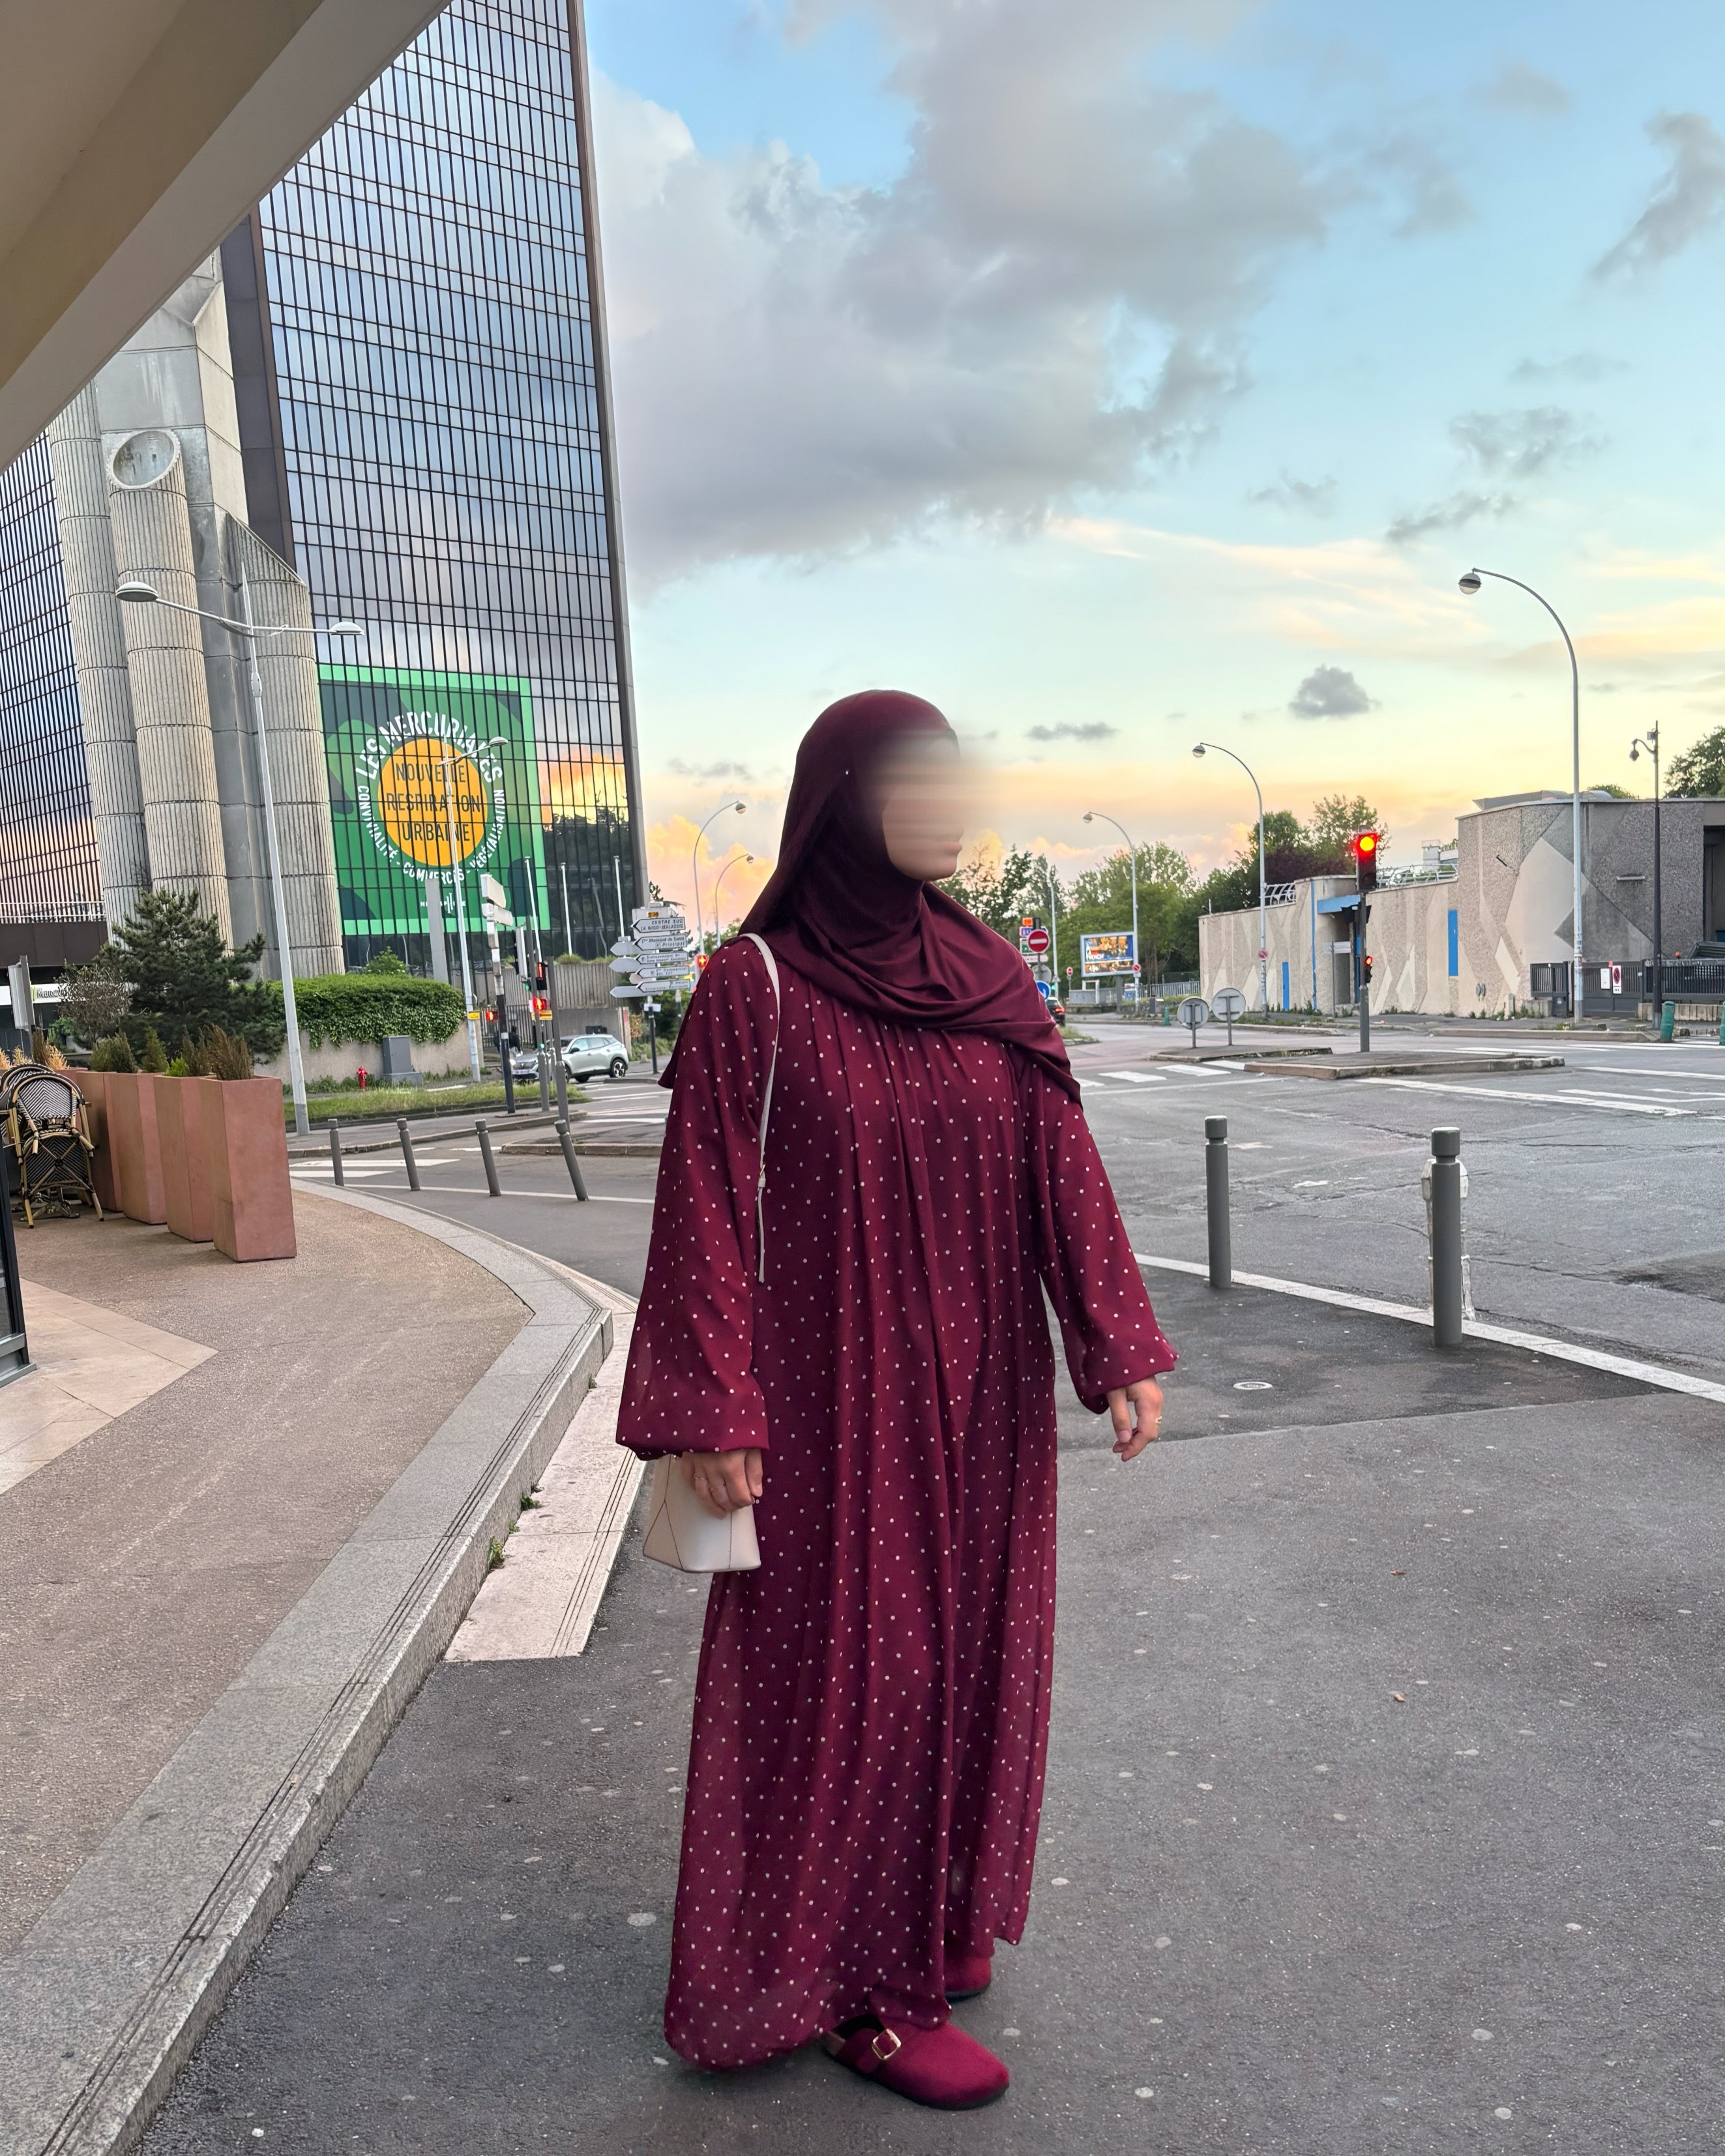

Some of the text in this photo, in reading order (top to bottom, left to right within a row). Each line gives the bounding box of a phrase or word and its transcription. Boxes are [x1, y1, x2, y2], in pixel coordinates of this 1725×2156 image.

[355, 710, 503, 783] LES MERCURIALES
[357, 785, 399, 863] CONVIVIALITÉ
[469, 789, 506, 871] VÉGÉTALISATION
[402, 823, 470, 841] URBAINE
